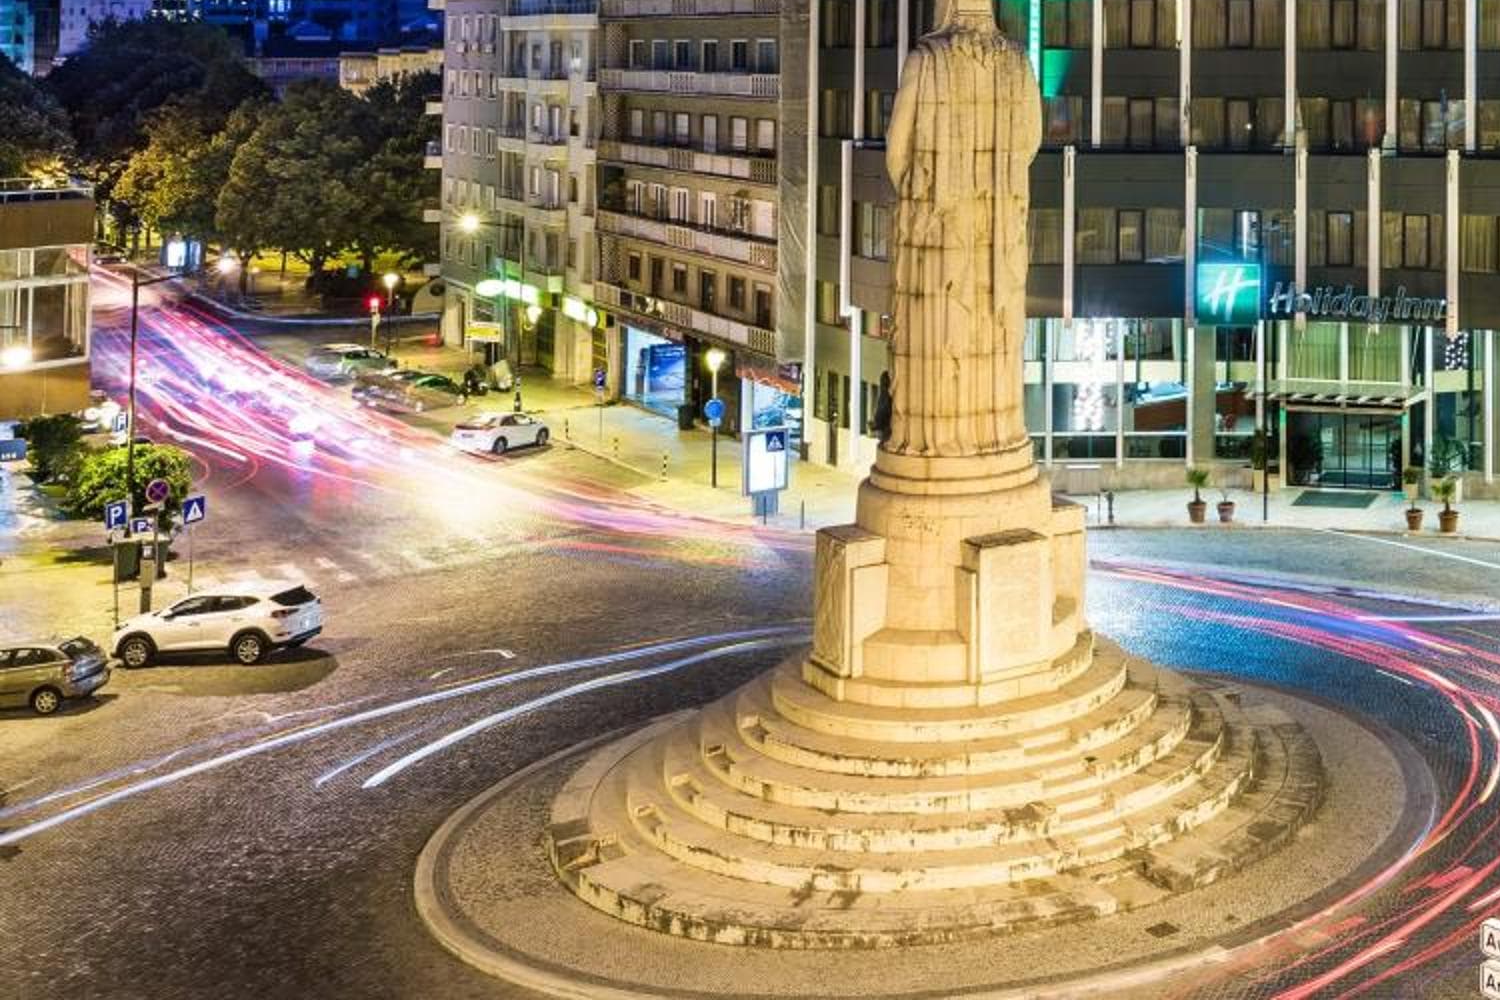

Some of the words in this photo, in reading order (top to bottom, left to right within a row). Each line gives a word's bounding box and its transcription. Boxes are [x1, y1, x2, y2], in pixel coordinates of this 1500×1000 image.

[1270, 281, 1390, 322] Holiday
[1393, 286, 1446, 320] Inn
[111, 506, 122, 525] P
